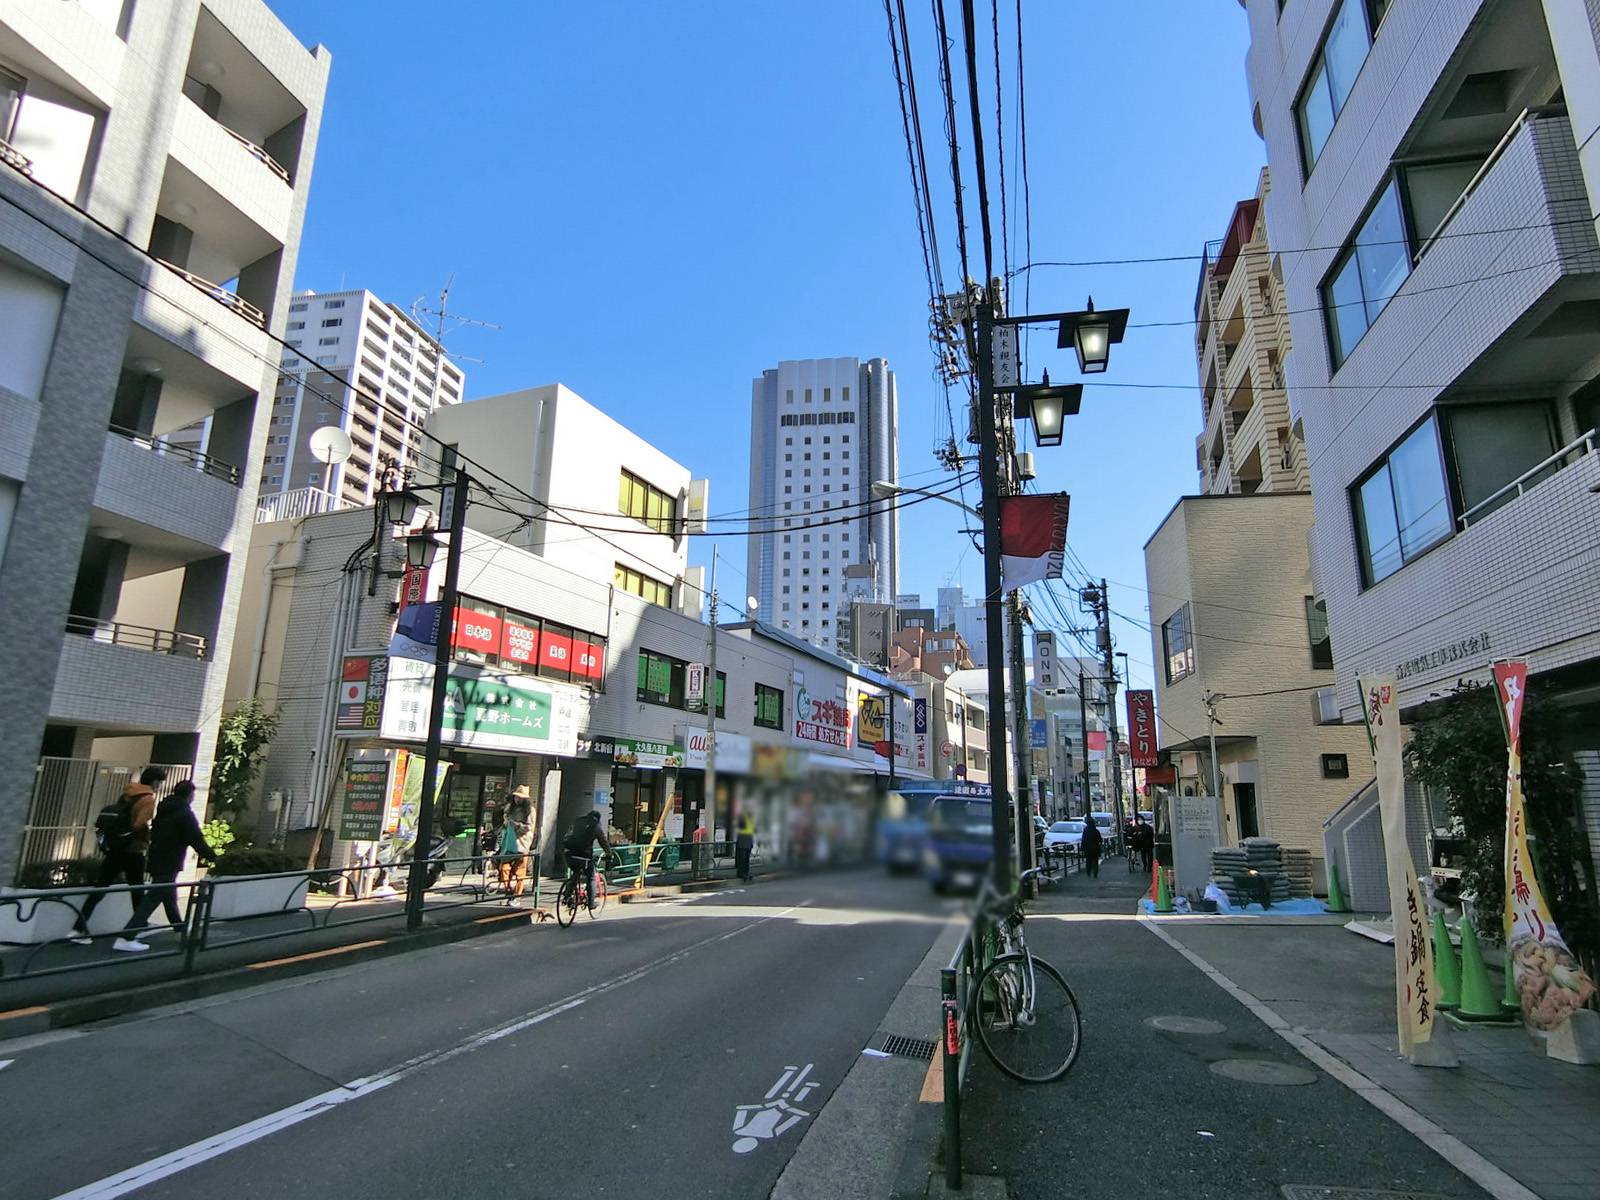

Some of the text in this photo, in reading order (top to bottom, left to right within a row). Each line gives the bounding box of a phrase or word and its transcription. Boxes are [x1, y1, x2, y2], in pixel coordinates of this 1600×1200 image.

[999, 329, 1010, 384] 柏木親友会
[1045, 542, 1066, 579] 2020
[430, 606, 443, 644] TOKYO 2020
[465, 624, 493, 641] 日本語
[363, 657, 388, 728] 多语种对应
[486, 692, 538, 710] 株式会社
[811, 699, 851, 729] スギ薬局
[916, 704, 926, 728] GEO
[1133, 692, 1149, 755] やきとり
[689, 735, 707, 751] au
[798, 721, 817, 740] 24時間
[916, 735, 926, 768] スギ薬局
